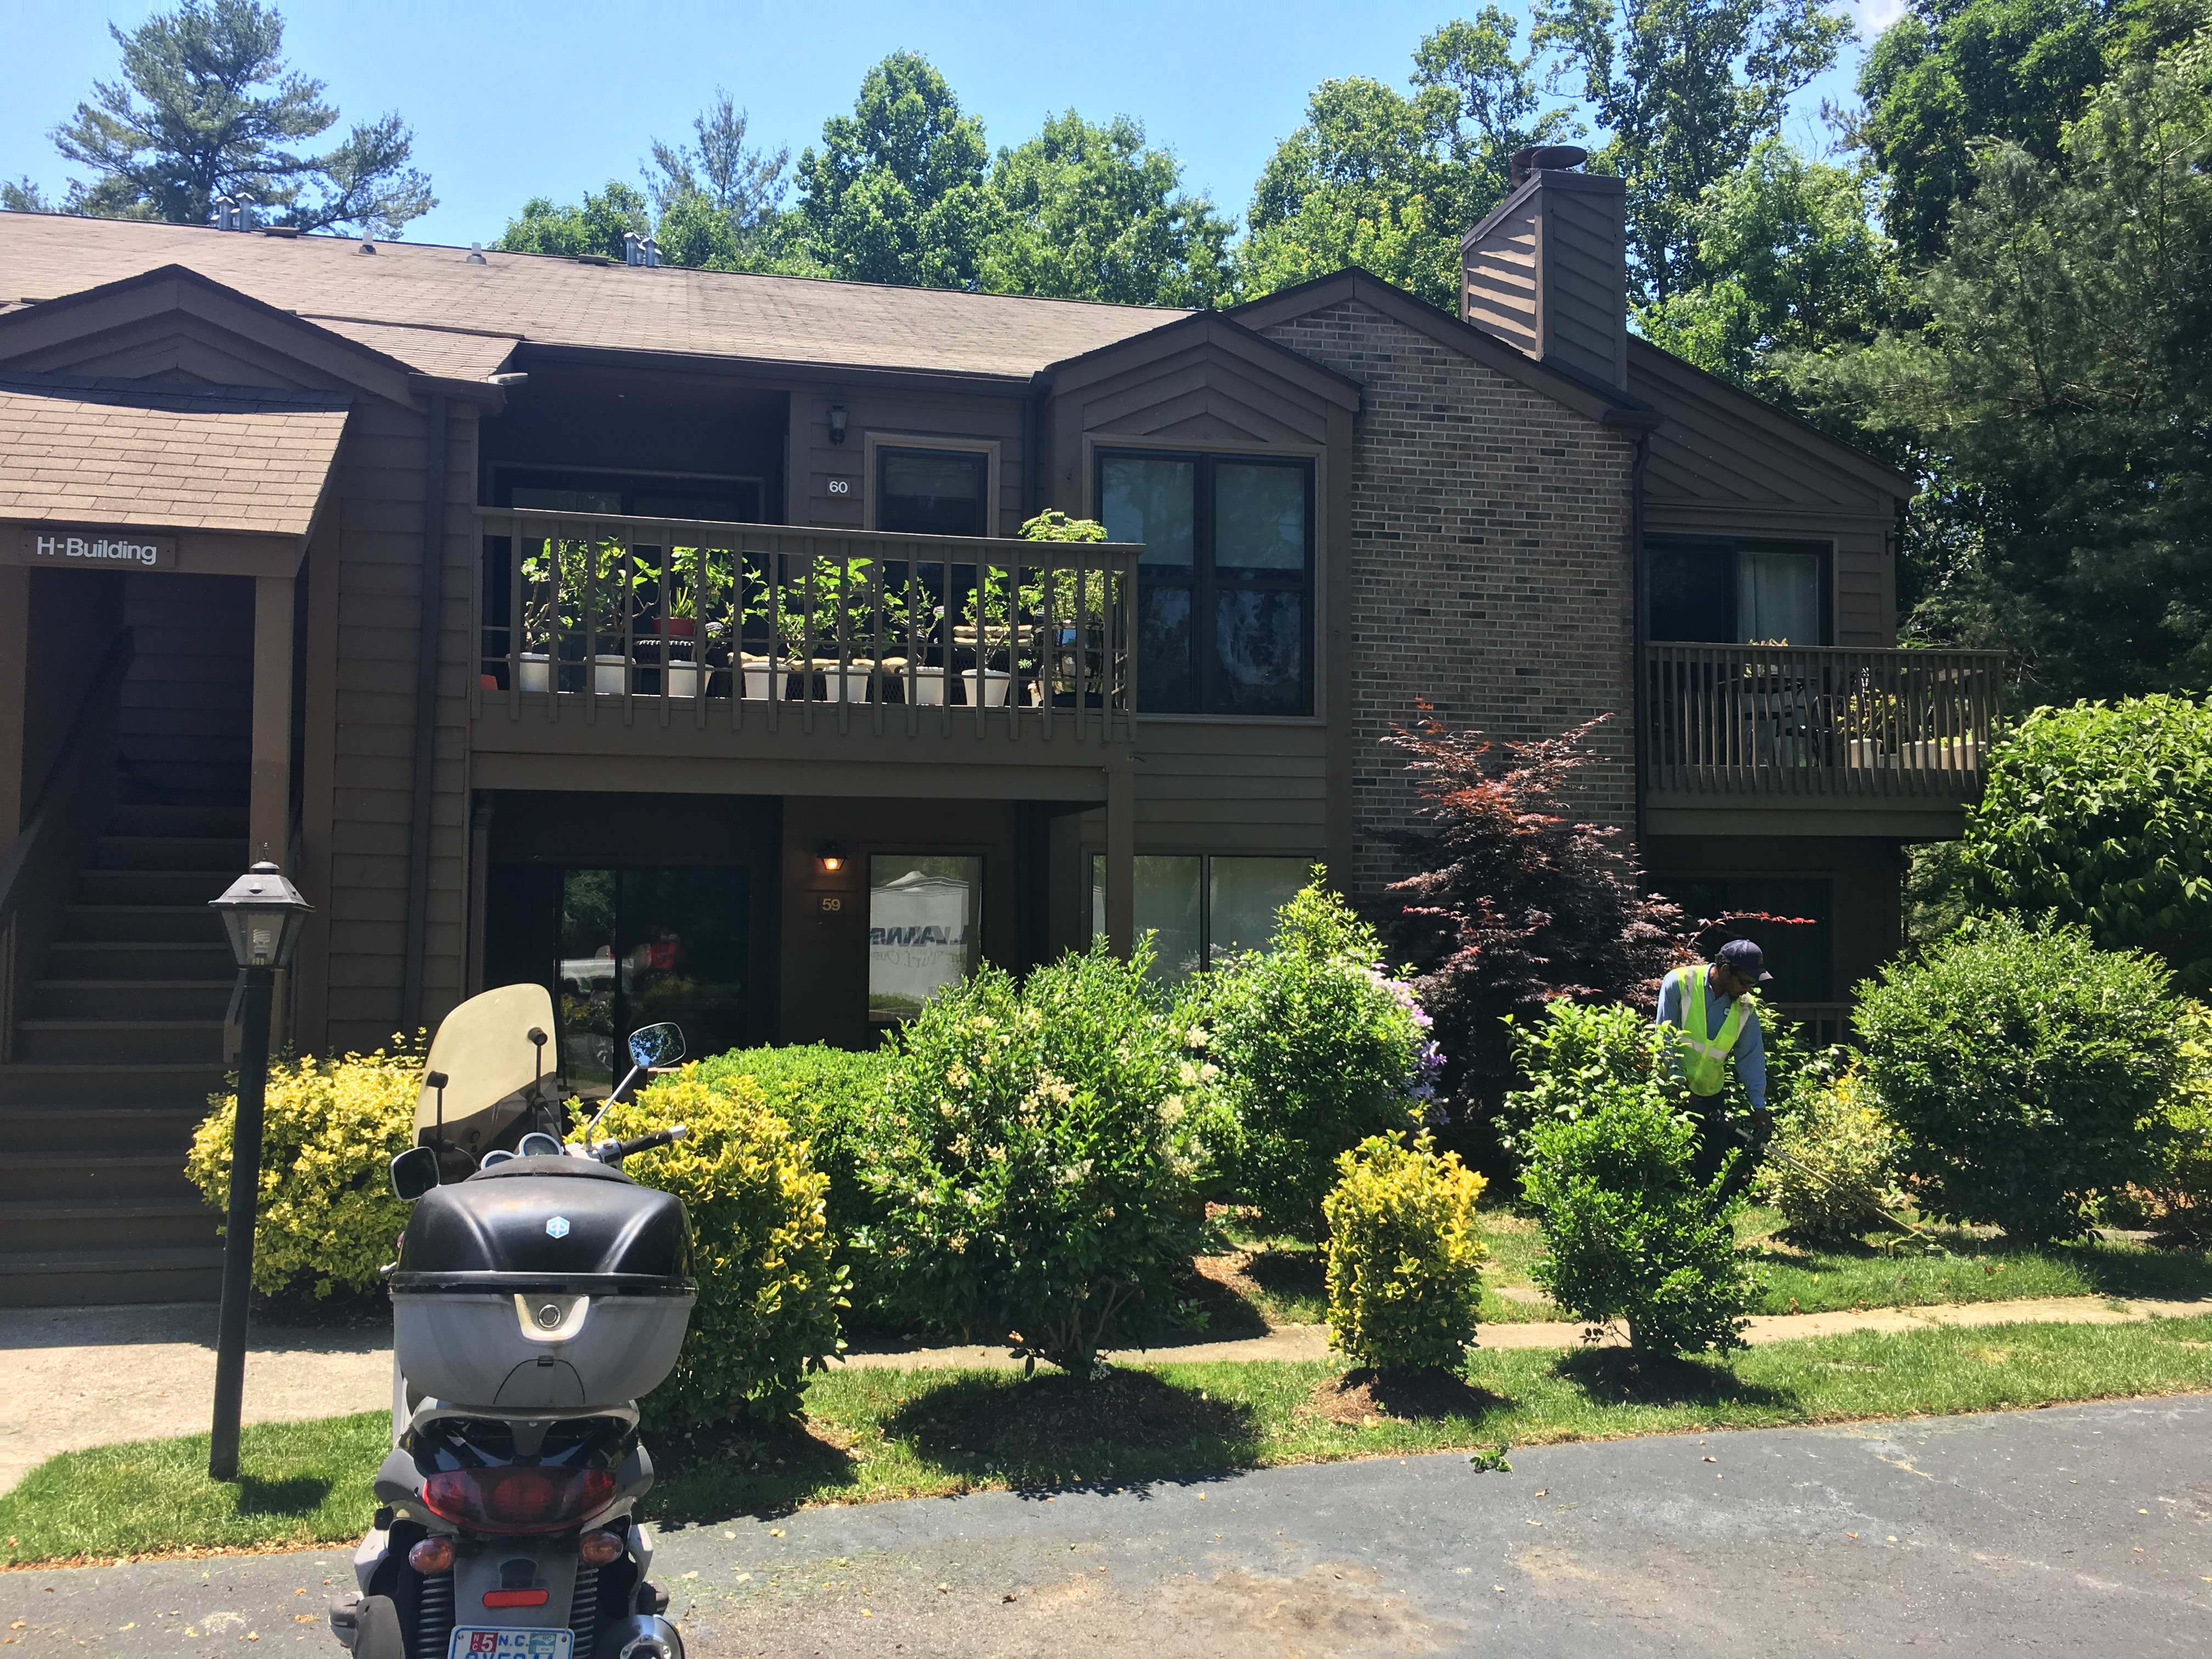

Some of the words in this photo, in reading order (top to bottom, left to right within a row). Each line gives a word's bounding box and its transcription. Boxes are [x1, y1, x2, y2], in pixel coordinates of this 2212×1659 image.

[829, 481, 848, 493] 60
[37, 535, 157, 566] H-Building
[822, 898, 841, 911] 59
[481, 1634, 494, 1652] 5
[498, 1635, 528, 1647] N.C.
